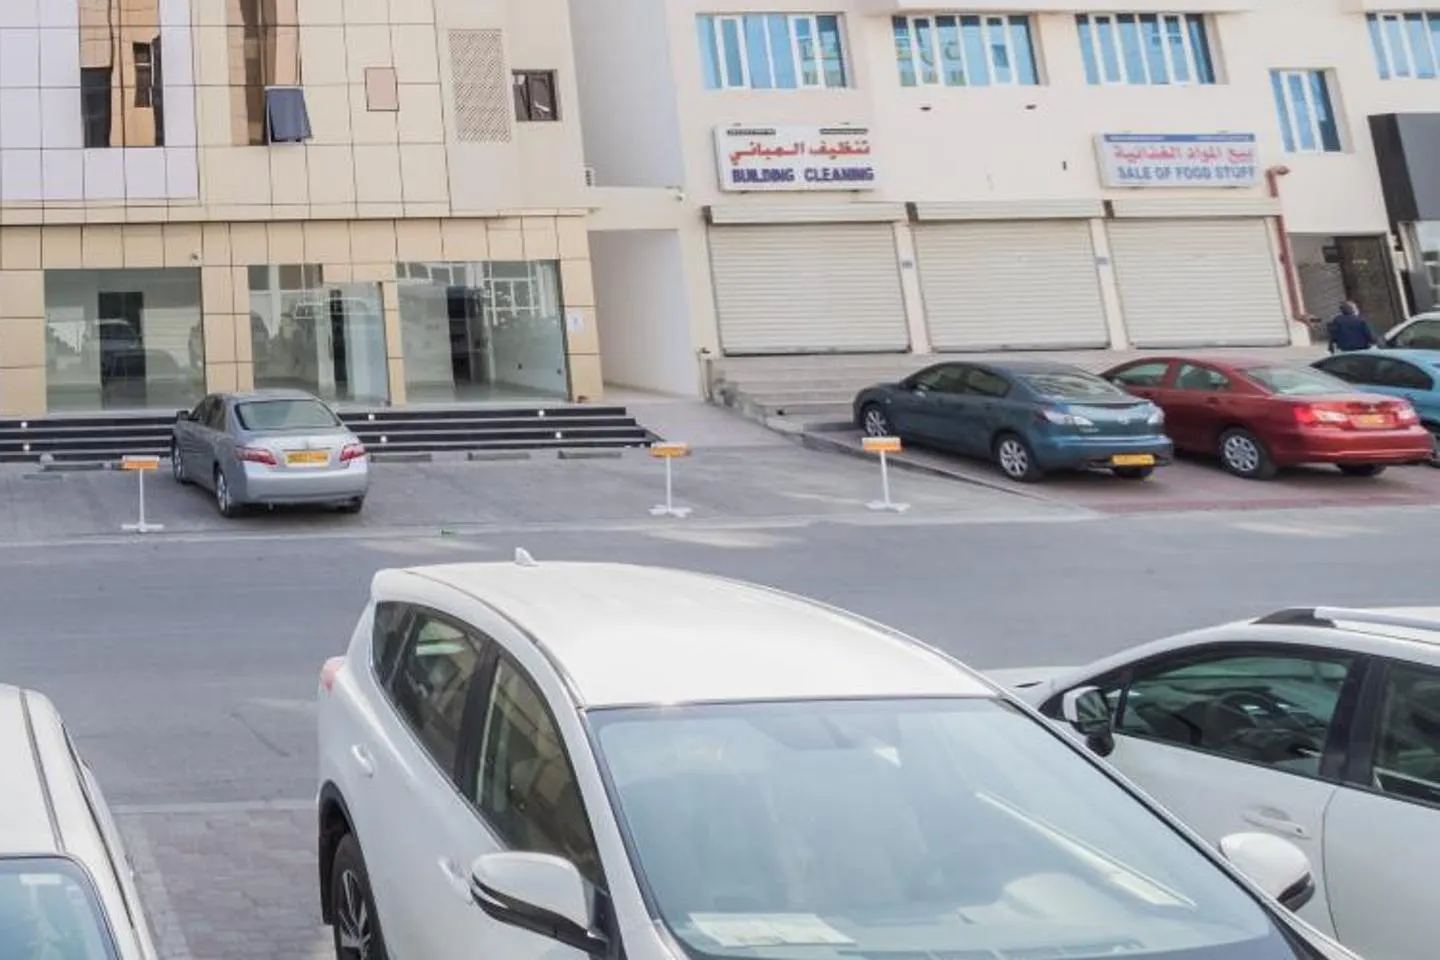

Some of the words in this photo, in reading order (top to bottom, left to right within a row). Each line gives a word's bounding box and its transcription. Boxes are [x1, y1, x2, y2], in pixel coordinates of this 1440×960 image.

[728, 141, 805, 166] المباني
[809, 139, 870, 160] تنظيف
[731, 167, 795, 183] BUILDING
[804, 166, 874, 182] CLEANING
[1118, 166, 1152, 180] SALE
[1155, 166, 1171, 180] OF
[1174, 166, 1211, 180] FOOD
[1215, 165, 1255, 179] STUFF
